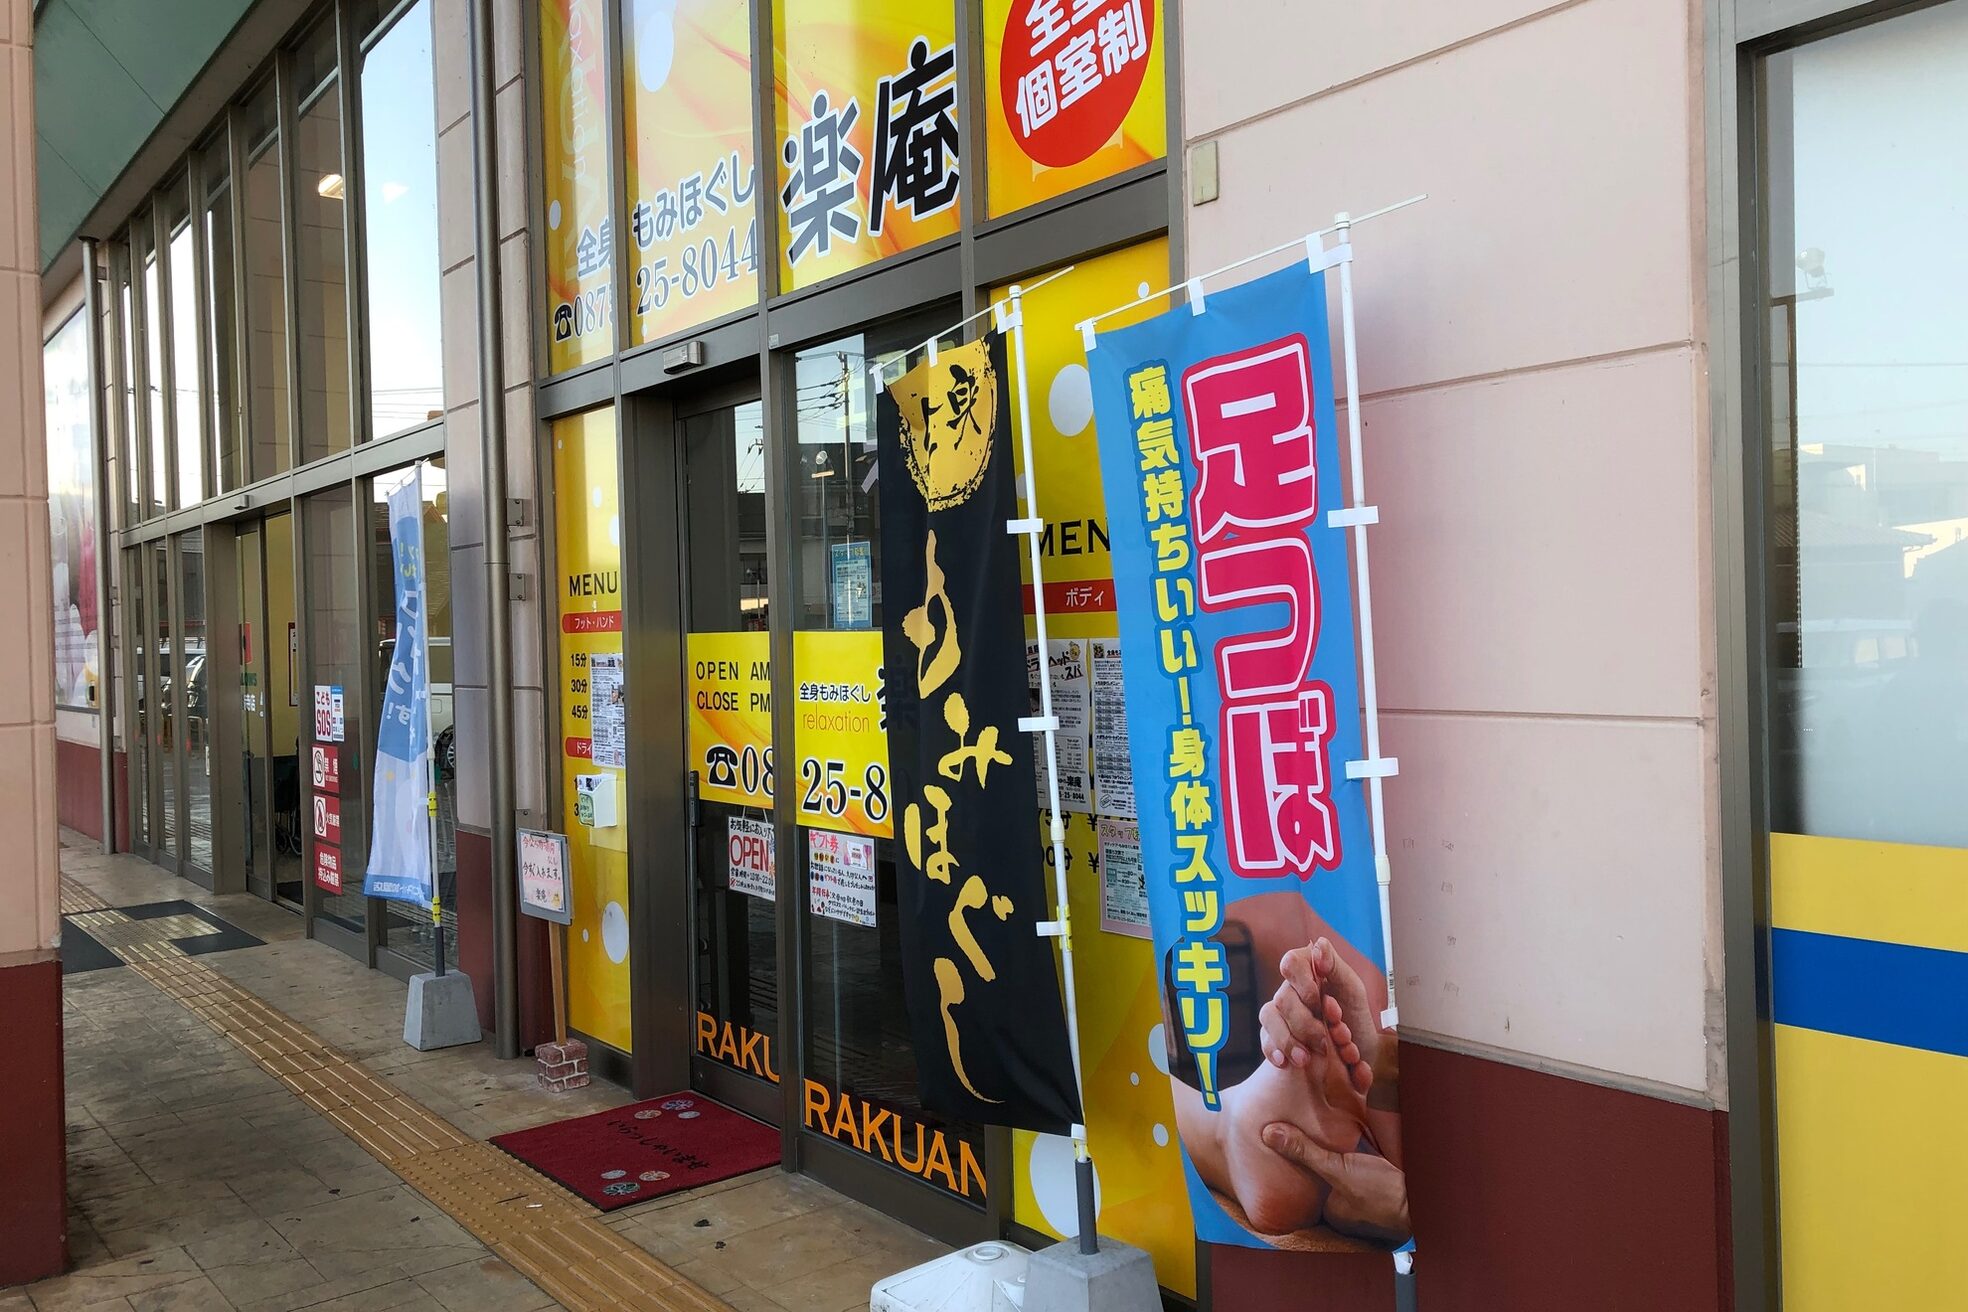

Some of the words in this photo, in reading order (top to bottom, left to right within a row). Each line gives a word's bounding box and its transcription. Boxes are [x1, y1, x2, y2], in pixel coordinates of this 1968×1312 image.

[1016, 0, 1147, 138] 個室制
[782, 36, 958, 267] 楽庵
[633, 151, 755, 249] もみほぐし
[637, 218, 758, 315] 25-8044
[569, 571, 618, 597] MENU
[1066, 586, 1104, 607] ボディ
[1185, 338, 1340, 876] 足つぼ
[574, 616, 614, 629] フット・ハンド
[571, 653, 586, 667] 15分
[696, 661, 739, 680] OPEN
[750, 661, 770, 681] AM
[1065, 663, 1082, 679] スパ
[571, 679, 587, 693] 30分
[800, 682, 871, 703] 全身もみほぐし
[571, 705, 588, 719] 45分
[697, 690, 739, 711] CLOSE
[751, 692, 771, 712] PM
[316, 709, 331, 737] SOS
[802, 704, 870, 733] relaxation
[802, 758, 888, 821] 25-8
[903, 529, 1013, 1104] もみほぐし
[730, 834, 769, 872] OPEN
[804, 1078, 987, 1198] RAKUAN
